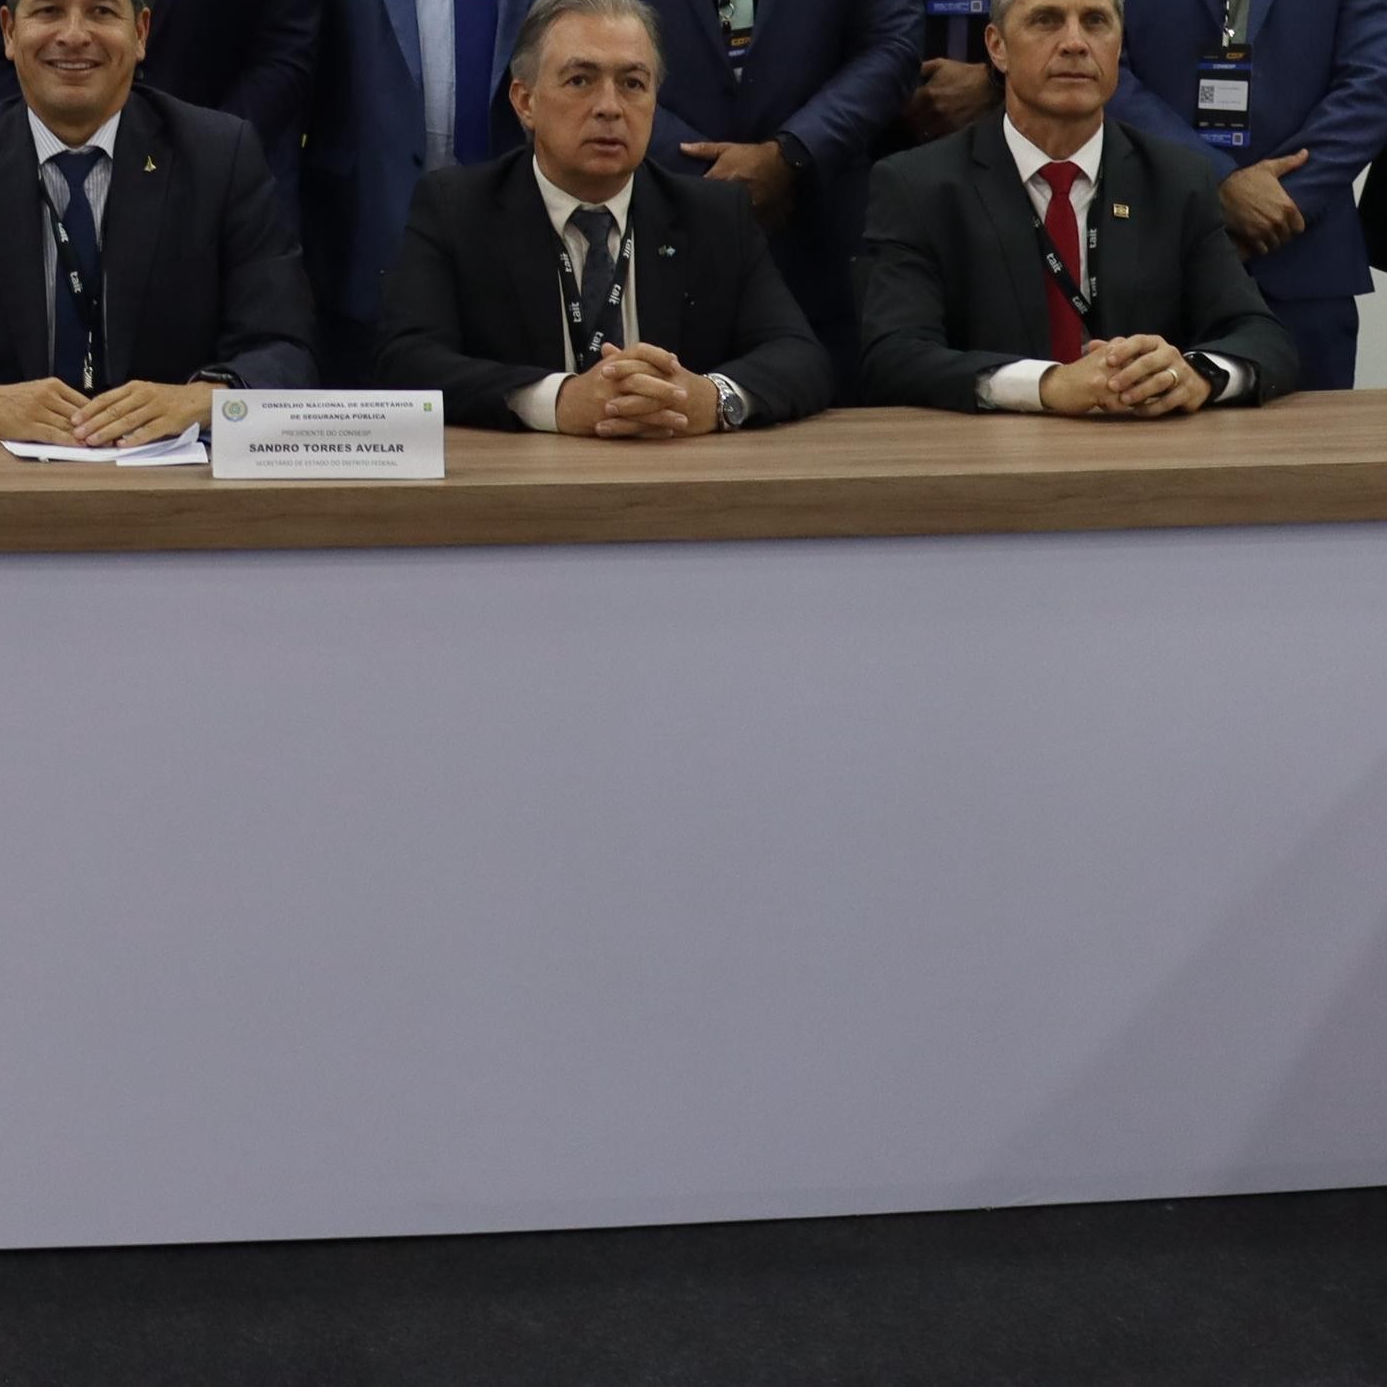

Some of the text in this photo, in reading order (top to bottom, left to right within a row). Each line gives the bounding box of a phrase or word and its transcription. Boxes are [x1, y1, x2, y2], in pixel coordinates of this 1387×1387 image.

[360, 400, 414, 408] SECRETÁRIOS
[303, 413, 350, 421] SEGURANÇA
[352, 412, 386, 420] PÚBLICA
[249, 444, 405, 453] SANDRO TORRES AVELAR
